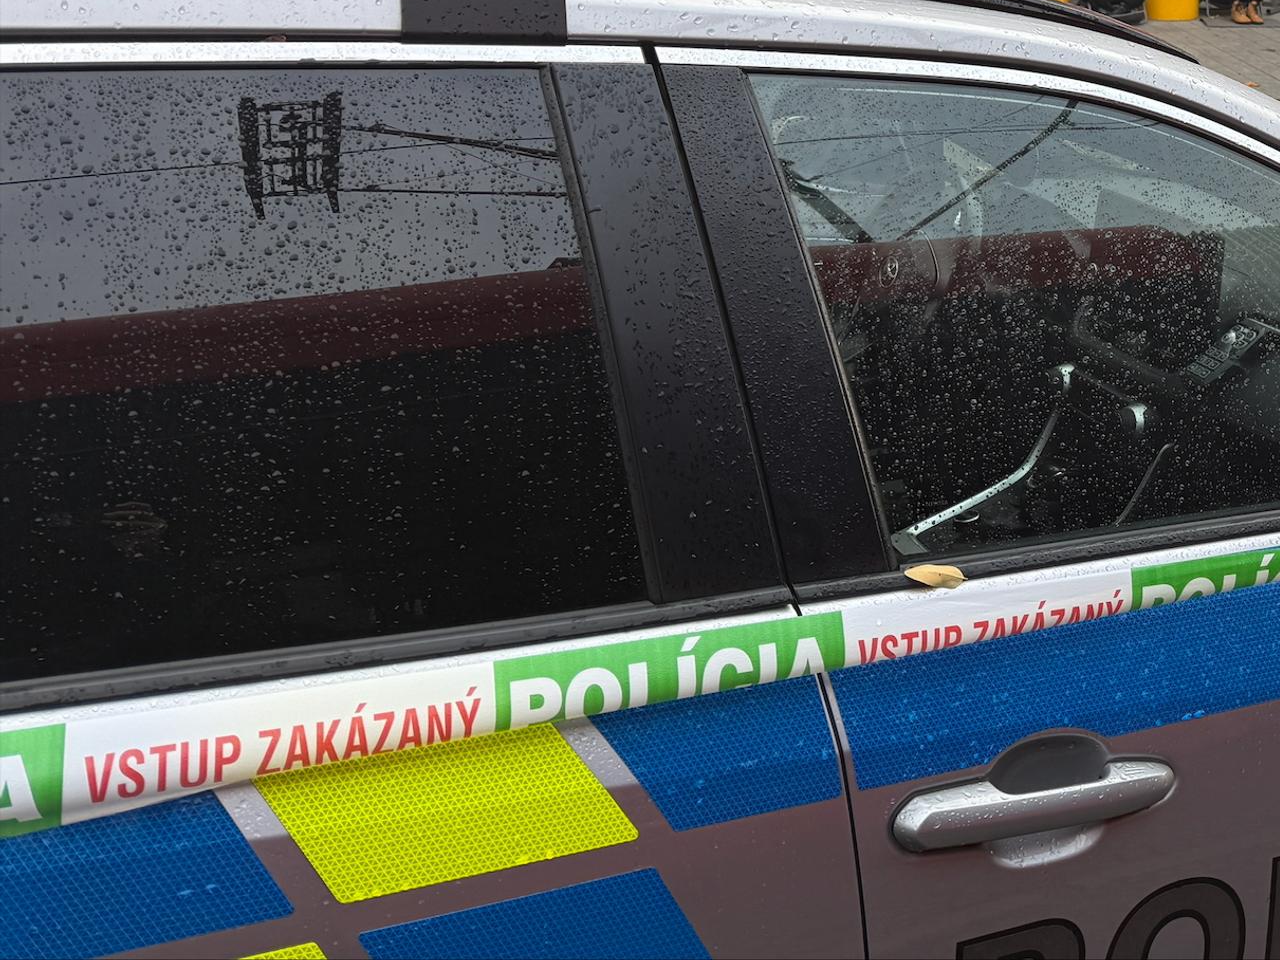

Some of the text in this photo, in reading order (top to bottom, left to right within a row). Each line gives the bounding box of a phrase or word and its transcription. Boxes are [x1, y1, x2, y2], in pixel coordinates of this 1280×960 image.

[85, 734, 242, 805] VSTUP
[256, 686, 482, 778] ZAKÁZANÝ
[858, 625, 963, 666] VSTUP
